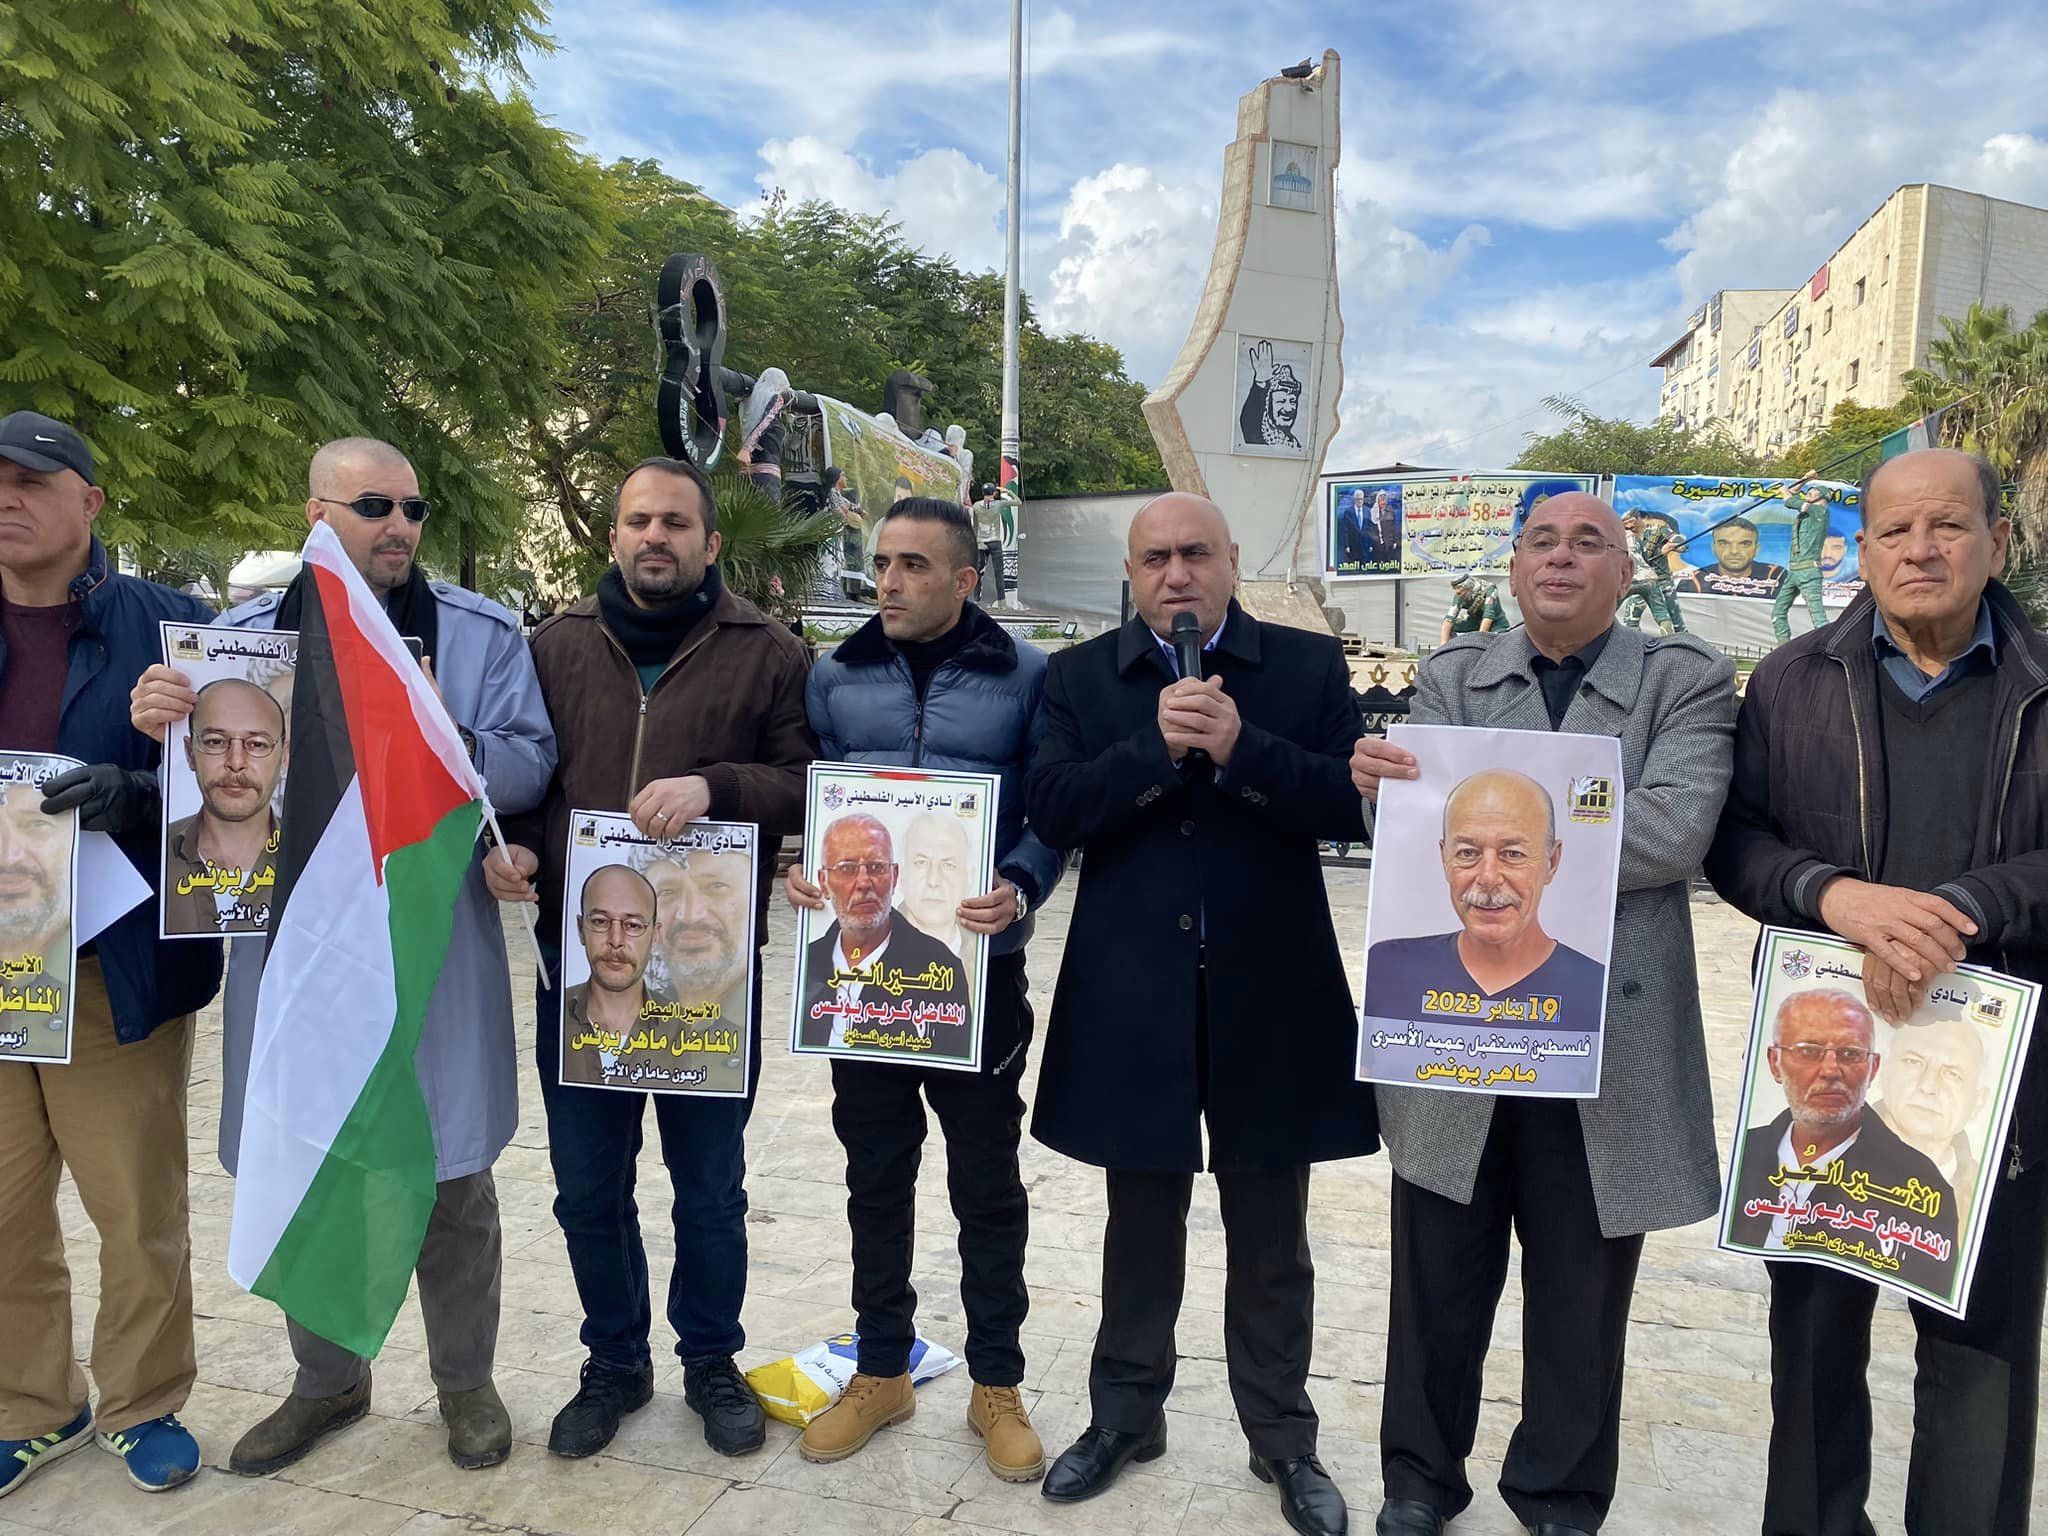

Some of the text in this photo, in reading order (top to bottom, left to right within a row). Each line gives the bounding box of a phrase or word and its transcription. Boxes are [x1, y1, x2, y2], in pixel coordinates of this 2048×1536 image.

[1472, 503, 1490, 521] 58
[1338, 560, 1360, 571] العهد
[206, 639, 289, 662] الفلسطيني
[0, 760, 59, 790] ادي الأسي
[846, 789, 953, 811] نادي الأسير الفلسطيني
[712, 832, 748, 856] نادي
[176, 858, 276, 895] هر يونس
[253, 902, 271, 927] في
[882, 961, 954, 996] الأسير
[1815, 960, 1969, 1006] نادي سطيني
[639, 999, 680, 1022] البطل
[811, 994, 966, 1026] المناضل كريم يونس
[1423, 989, 1560, 1024] 19 يناير 2023
[0, 1027, 28, 1049] أربعو
[571, 1022, 739, 1058] المناضل ماهر يونس
[843, 1028, 879, 1047] فلسطين
[905, 1033, 933, 1051] عميد
[1370, 1021, 1592, 1061] فلسطين تستقبل عميد الأسرى
[630, 1063, 643, 1084] في
[671, 1064, 708, 1087] أربعون
[1416, 1056, 1537, 1086] ماهر يونس
[1840, 1170, 1942, 1218] الأسير
[1744, 1193, 1952, 1262] المناضل كريم يونس
[1782, 1229, 1828, 1250] فلسطين
[1863, 1247, 1900, 1271] عميد
